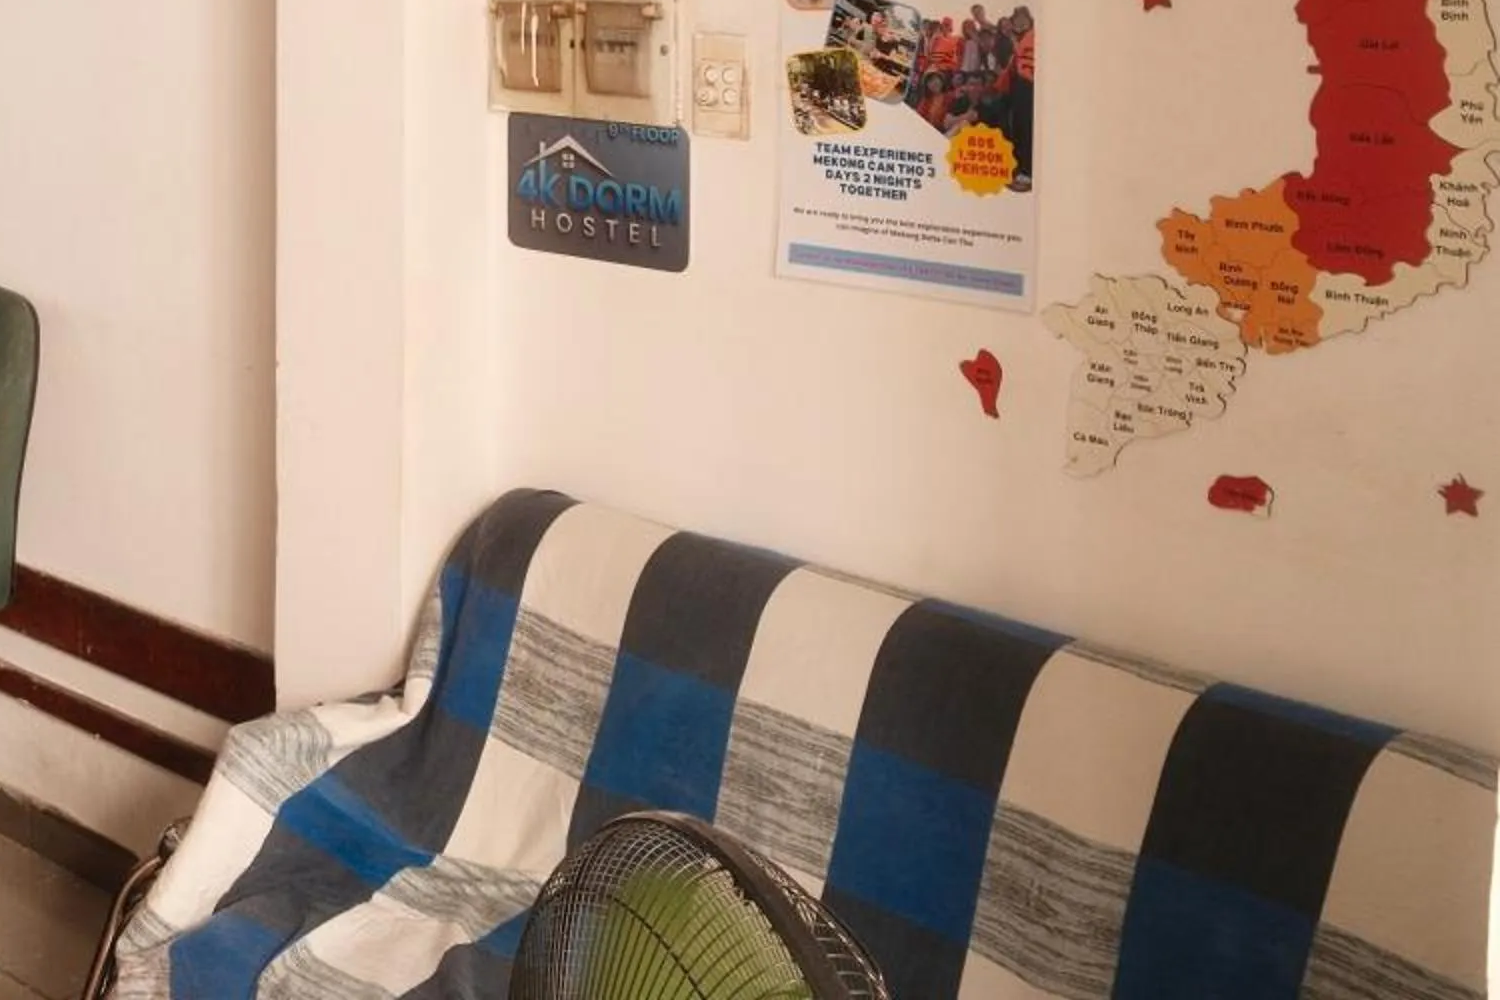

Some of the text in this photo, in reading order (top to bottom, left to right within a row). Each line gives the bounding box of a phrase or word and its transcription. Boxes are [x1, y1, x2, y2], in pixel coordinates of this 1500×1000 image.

[815, 141, 933, 164] TEAM EXPERIENCE
[813, 154, 936, 178] MEKONG CAN THO 3
[953, 162, 1010, 178] PERSON
[825, 168, 923, 190] DAYS 2 NIGHTS
[570, 173, 681, 226] DORM
[839, 182, 908, 201] TOGETHER
[530, 208, 662, 248] HOSTEL
[1166, 303, 1193, 317] Long
